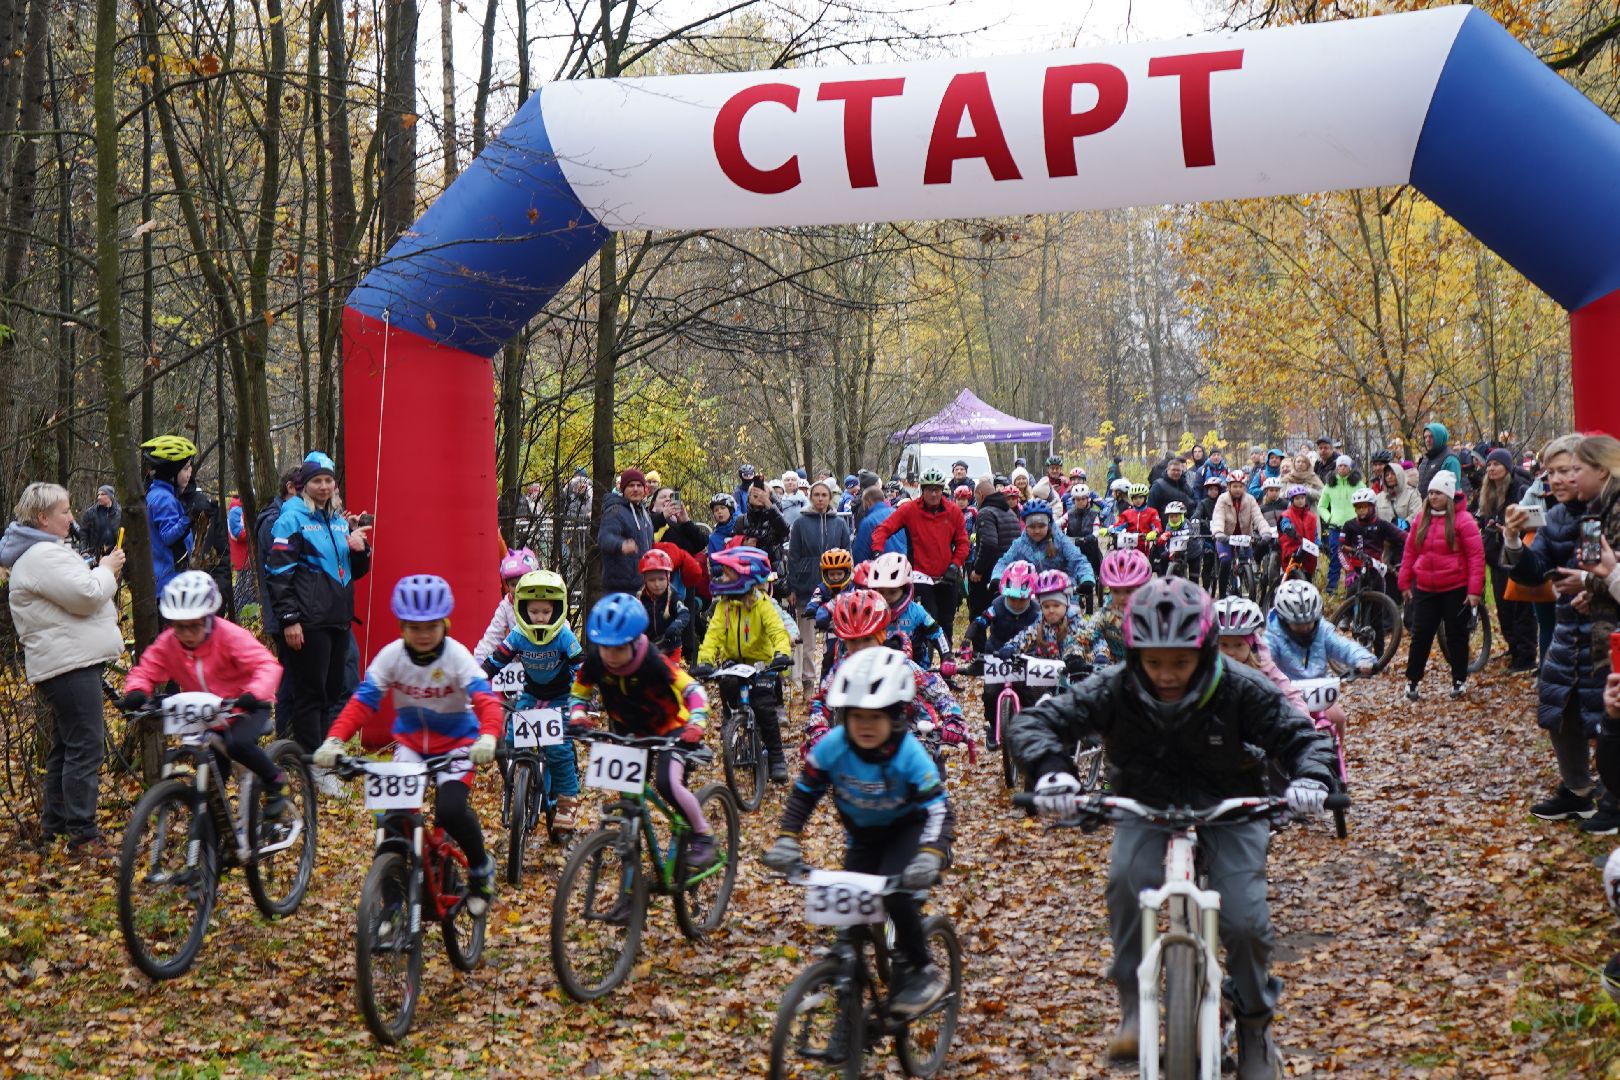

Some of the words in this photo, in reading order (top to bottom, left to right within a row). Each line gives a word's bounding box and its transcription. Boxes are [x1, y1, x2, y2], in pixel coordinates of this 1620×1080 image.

[713, 49, 1244, 194] СТАРТ
[494, 670, 526, 685] 386
[166, 704, 214, 724] 160
[515, 720, 561, 739] 416
[593, 756, 642, 783] 102
[368, 774, 420, 797] 389
[813, 885, 875, 915] 388
